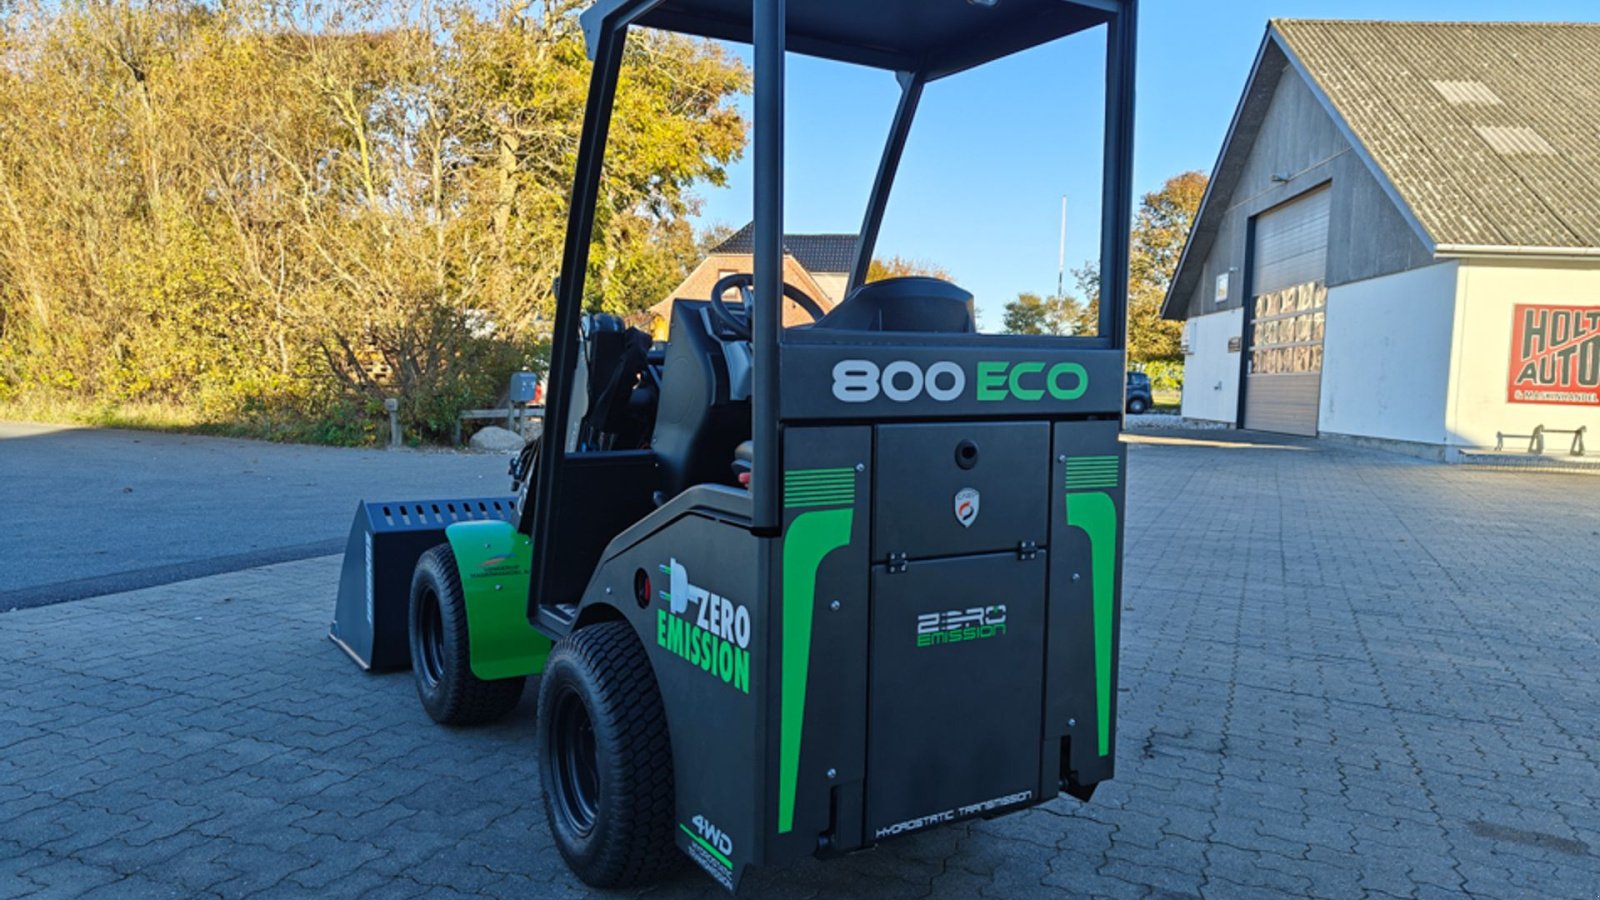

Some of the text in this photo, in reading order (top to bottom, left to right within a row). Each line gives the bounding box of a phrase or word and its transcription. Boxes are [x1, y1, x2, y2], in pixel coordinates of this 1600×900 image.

[1521, 308, 1600, 361] HOLT
[832, 359, 1089, 402] 800 ECO
[1515, 334, 1600, 387] AUTO
[696, 587, 751, 649] ZERO
[917, 623, 1007, 647] EMISSION
[657, 608, 751, 694] EMISSION
[692, 814, 733, 856] 4WD
[875, 810, 954, 838] HYDROSTATIC
